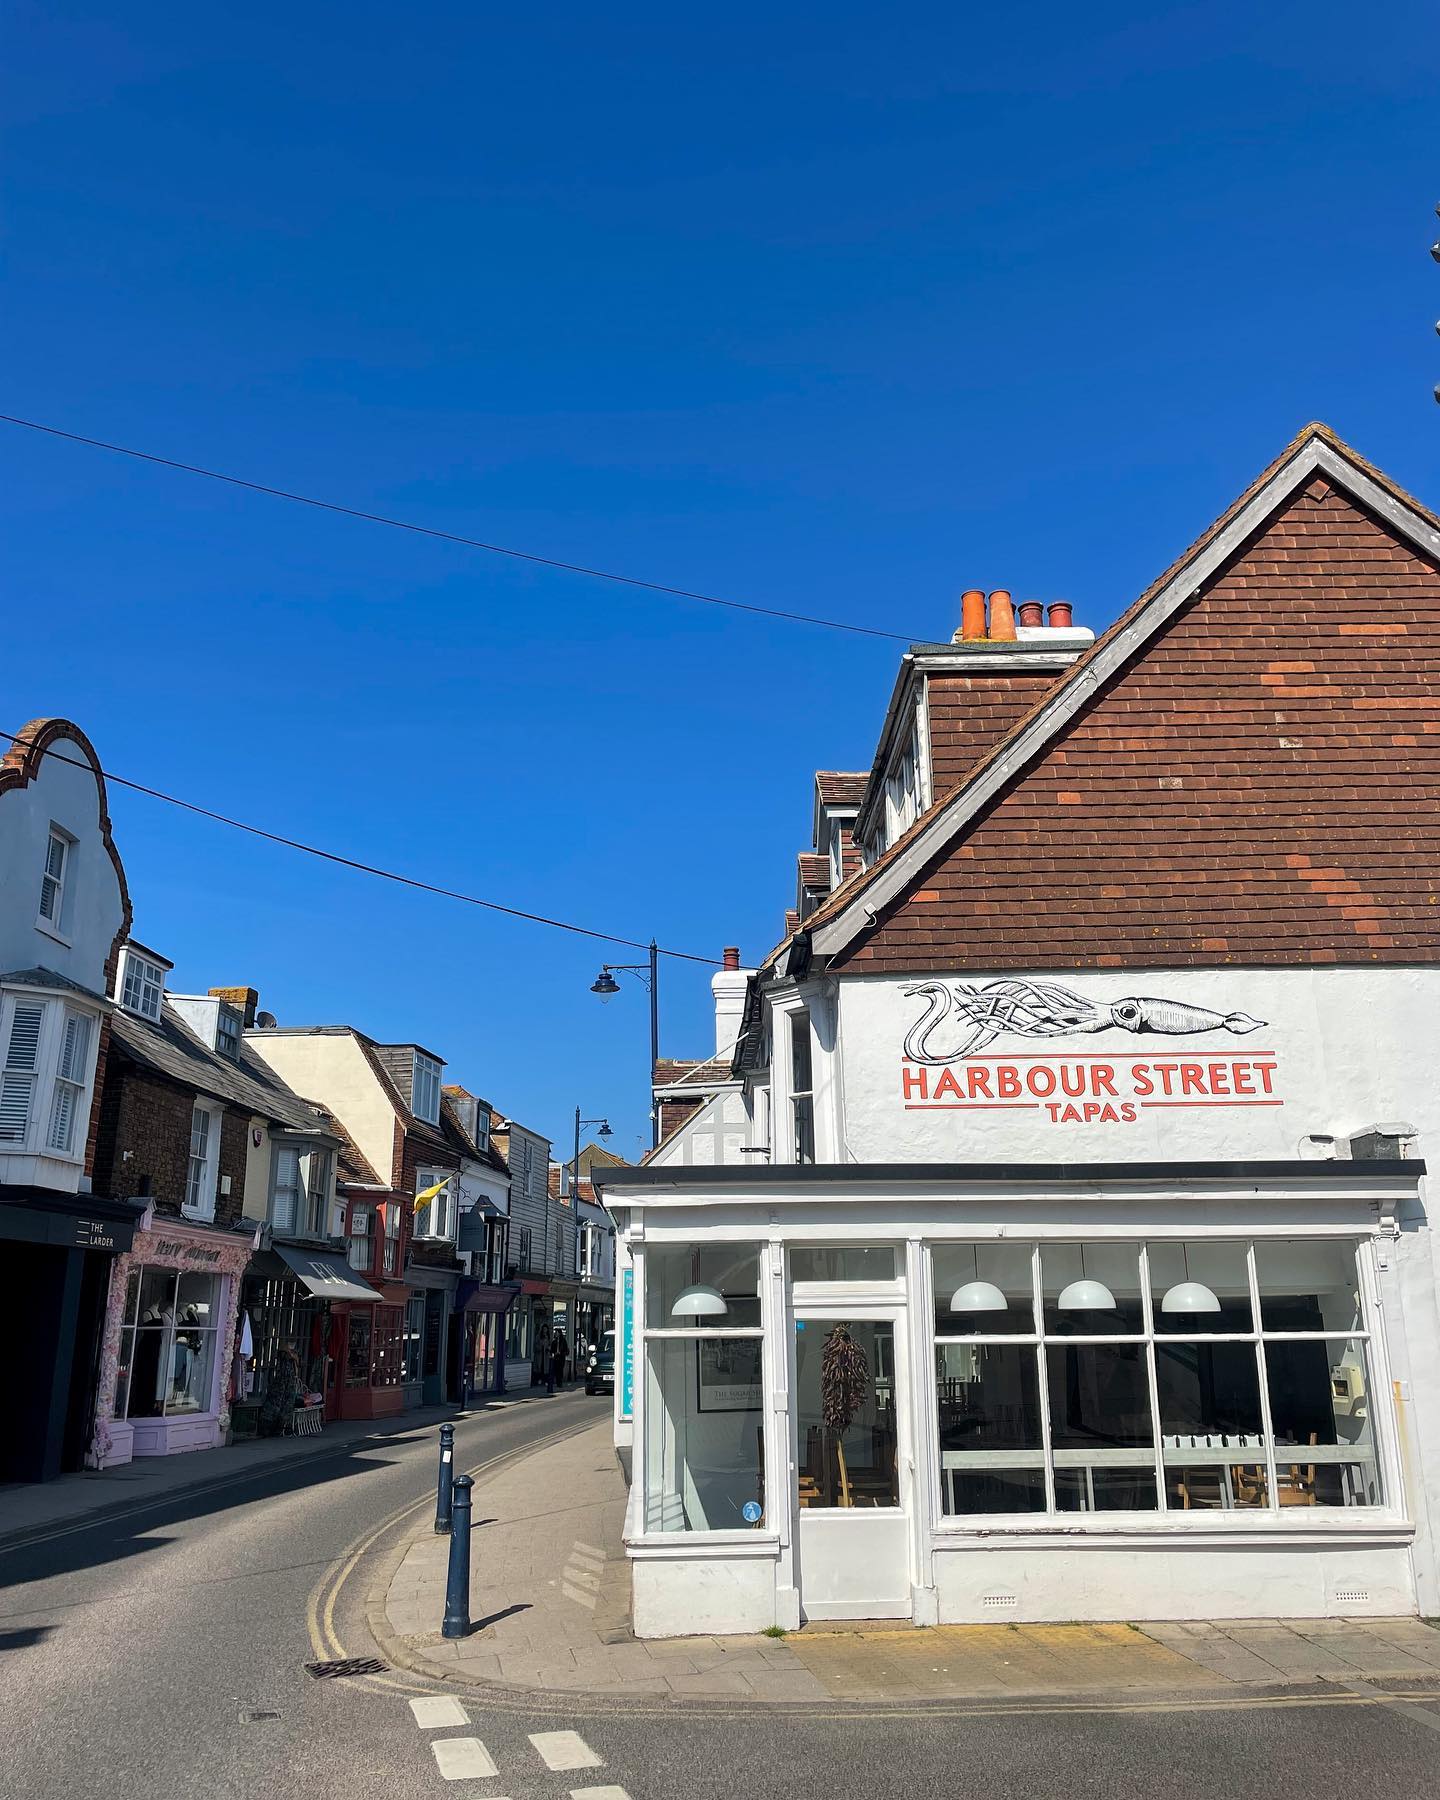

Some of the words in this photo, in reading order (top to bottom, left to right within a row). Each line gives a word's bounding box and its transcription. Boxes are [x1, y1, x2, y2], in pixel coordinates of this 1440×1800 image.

[901, 1064, 1119, 1100] HARBOUR
[1131, 1062, 1278, 1096] STREET
[1045, 1102, 1138, 1123] TAPAS
[90, 1222, 104, 1233] THE
[89, 1235, 114, 1247] LARDER
